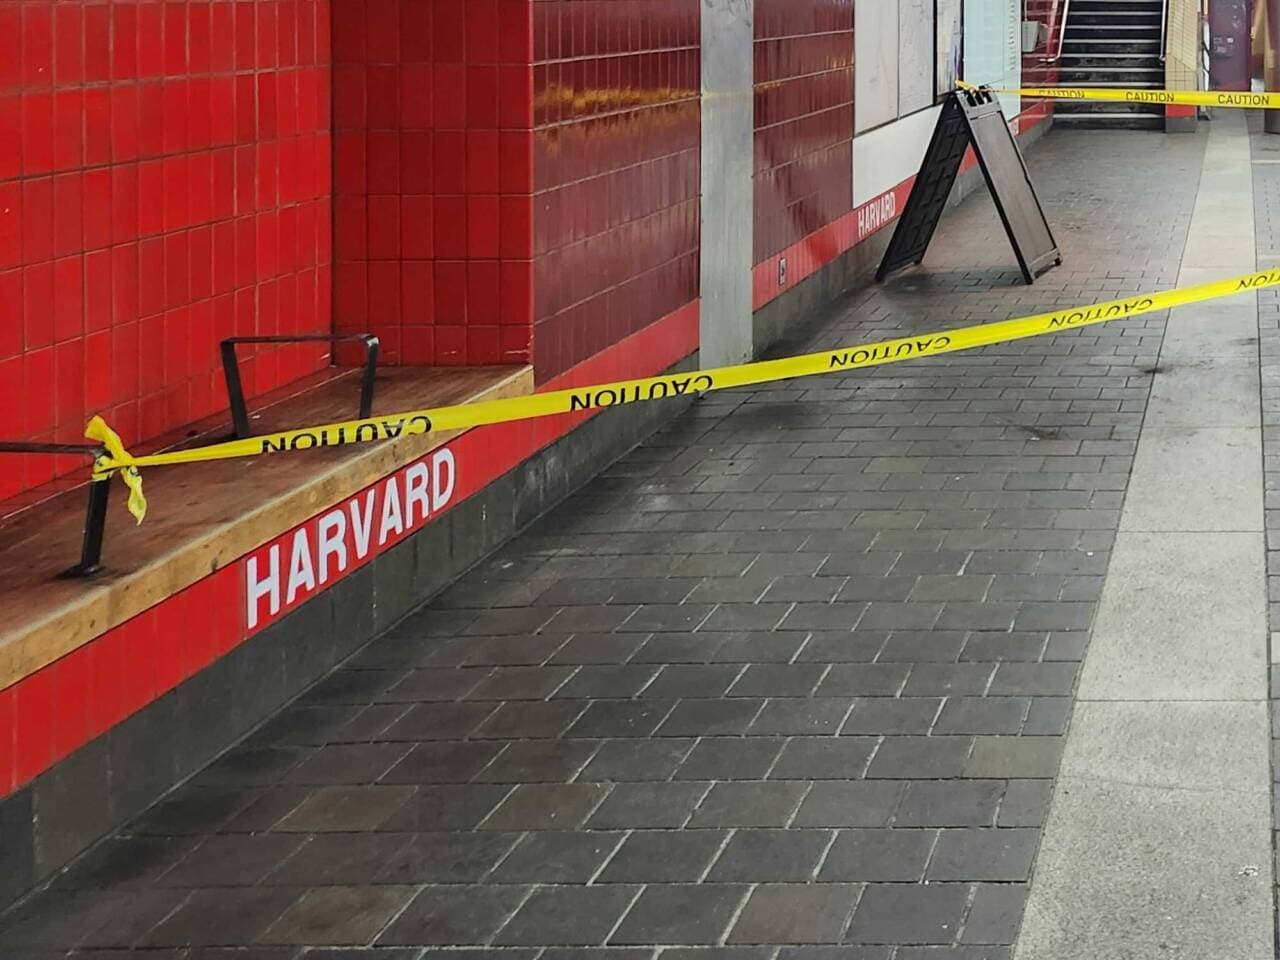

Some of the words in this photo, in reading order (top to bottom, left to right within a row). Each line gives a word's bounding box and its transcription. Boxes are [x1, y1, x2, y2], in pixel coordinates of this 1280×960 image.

[1126, 91, 1175, 103] CAUTION
[1218, 93, 1269, 105] CAUTION
[858, 191, 896, 239] HARVARD
[1048, 298, 1153, 329] CAUTION
[830, 335, 951, 368] CAUTION
[571, 375, 713, 412] CAUTION
[262, 415, 432, 454] CAUTION
[246, 447, 456, 629] HARVARD
